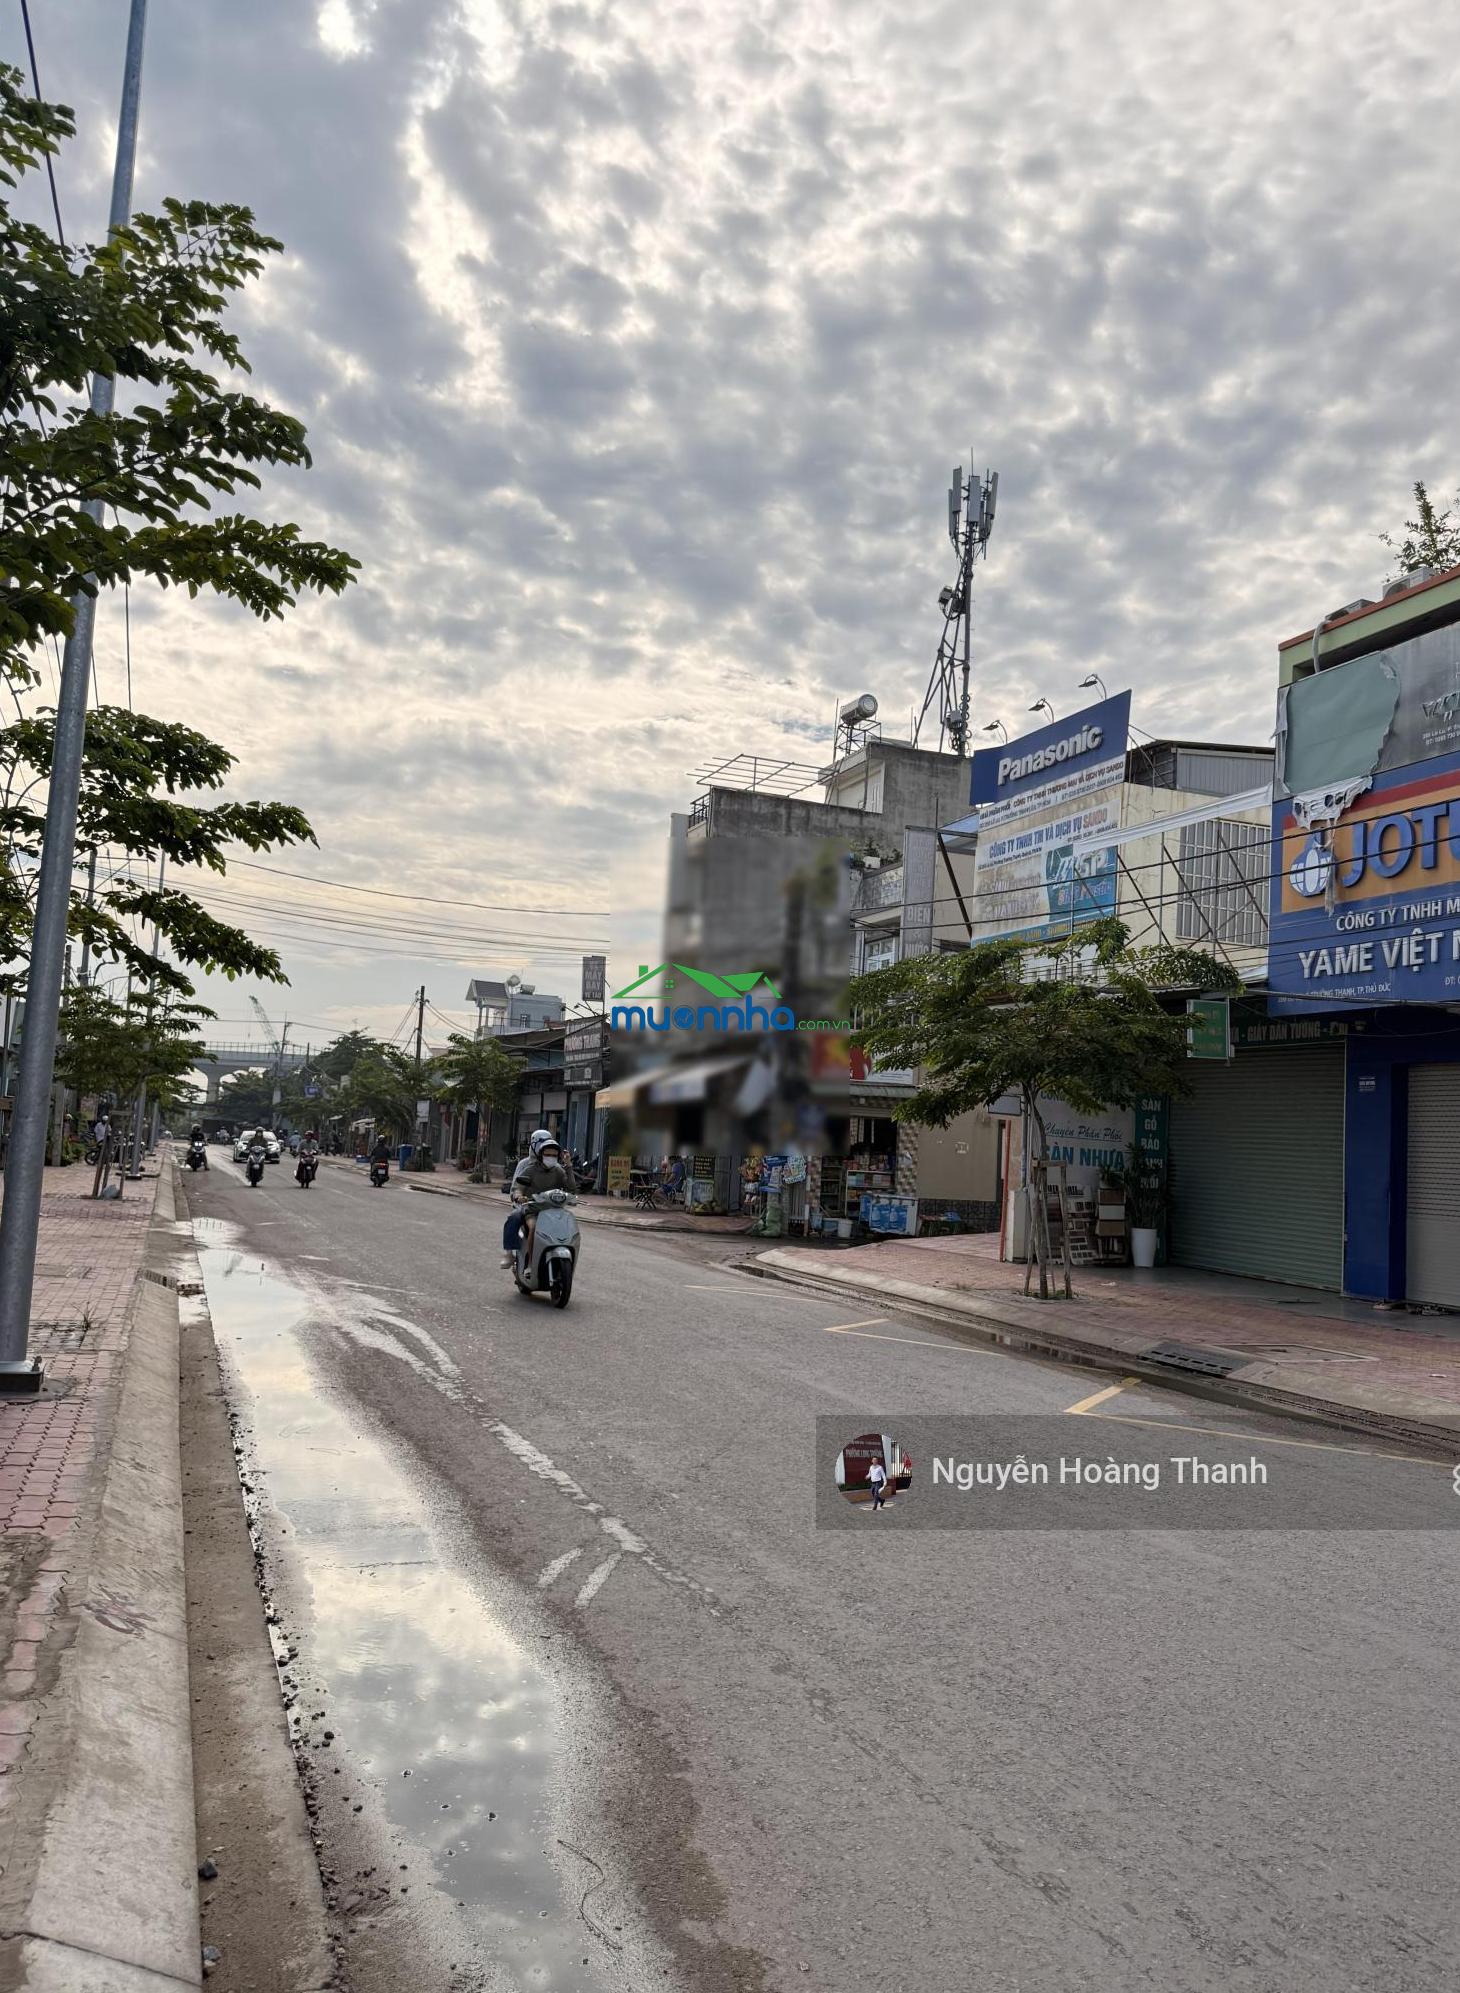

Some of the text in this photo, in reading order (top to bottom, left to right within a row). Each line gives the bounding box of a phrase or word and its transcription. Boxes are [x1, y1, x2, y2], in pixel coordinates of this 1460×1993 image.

[998, 725, 1102, 785] Panasonic
[1027, 795, 1034, 804] TY
[990, 841, 1006, 859] CÔNG
[1007, 838, 1015, 852] TY
[1016, 834, 1033, 850] TNHH
[1045, 825, 1054, 841] VÀ
[1055, 821, 1071, 841] DỊCH
[1073, 816, 1082, 834] VỤ
[1083, 808, 1108, 829] SANDO
[1336, 911, 1375, 931] CÔNG
[1379, 906, 1396, 925] TY
[1403, 900, 1441, 921] TNHH
[1299, 942, 1374, 979] YAME
[1382, 928, 1445, 972] VIỆT
[1378, 981, 1391, 993] ĐỨC
[1080, 1148, 1125, 1168] NHỰA
